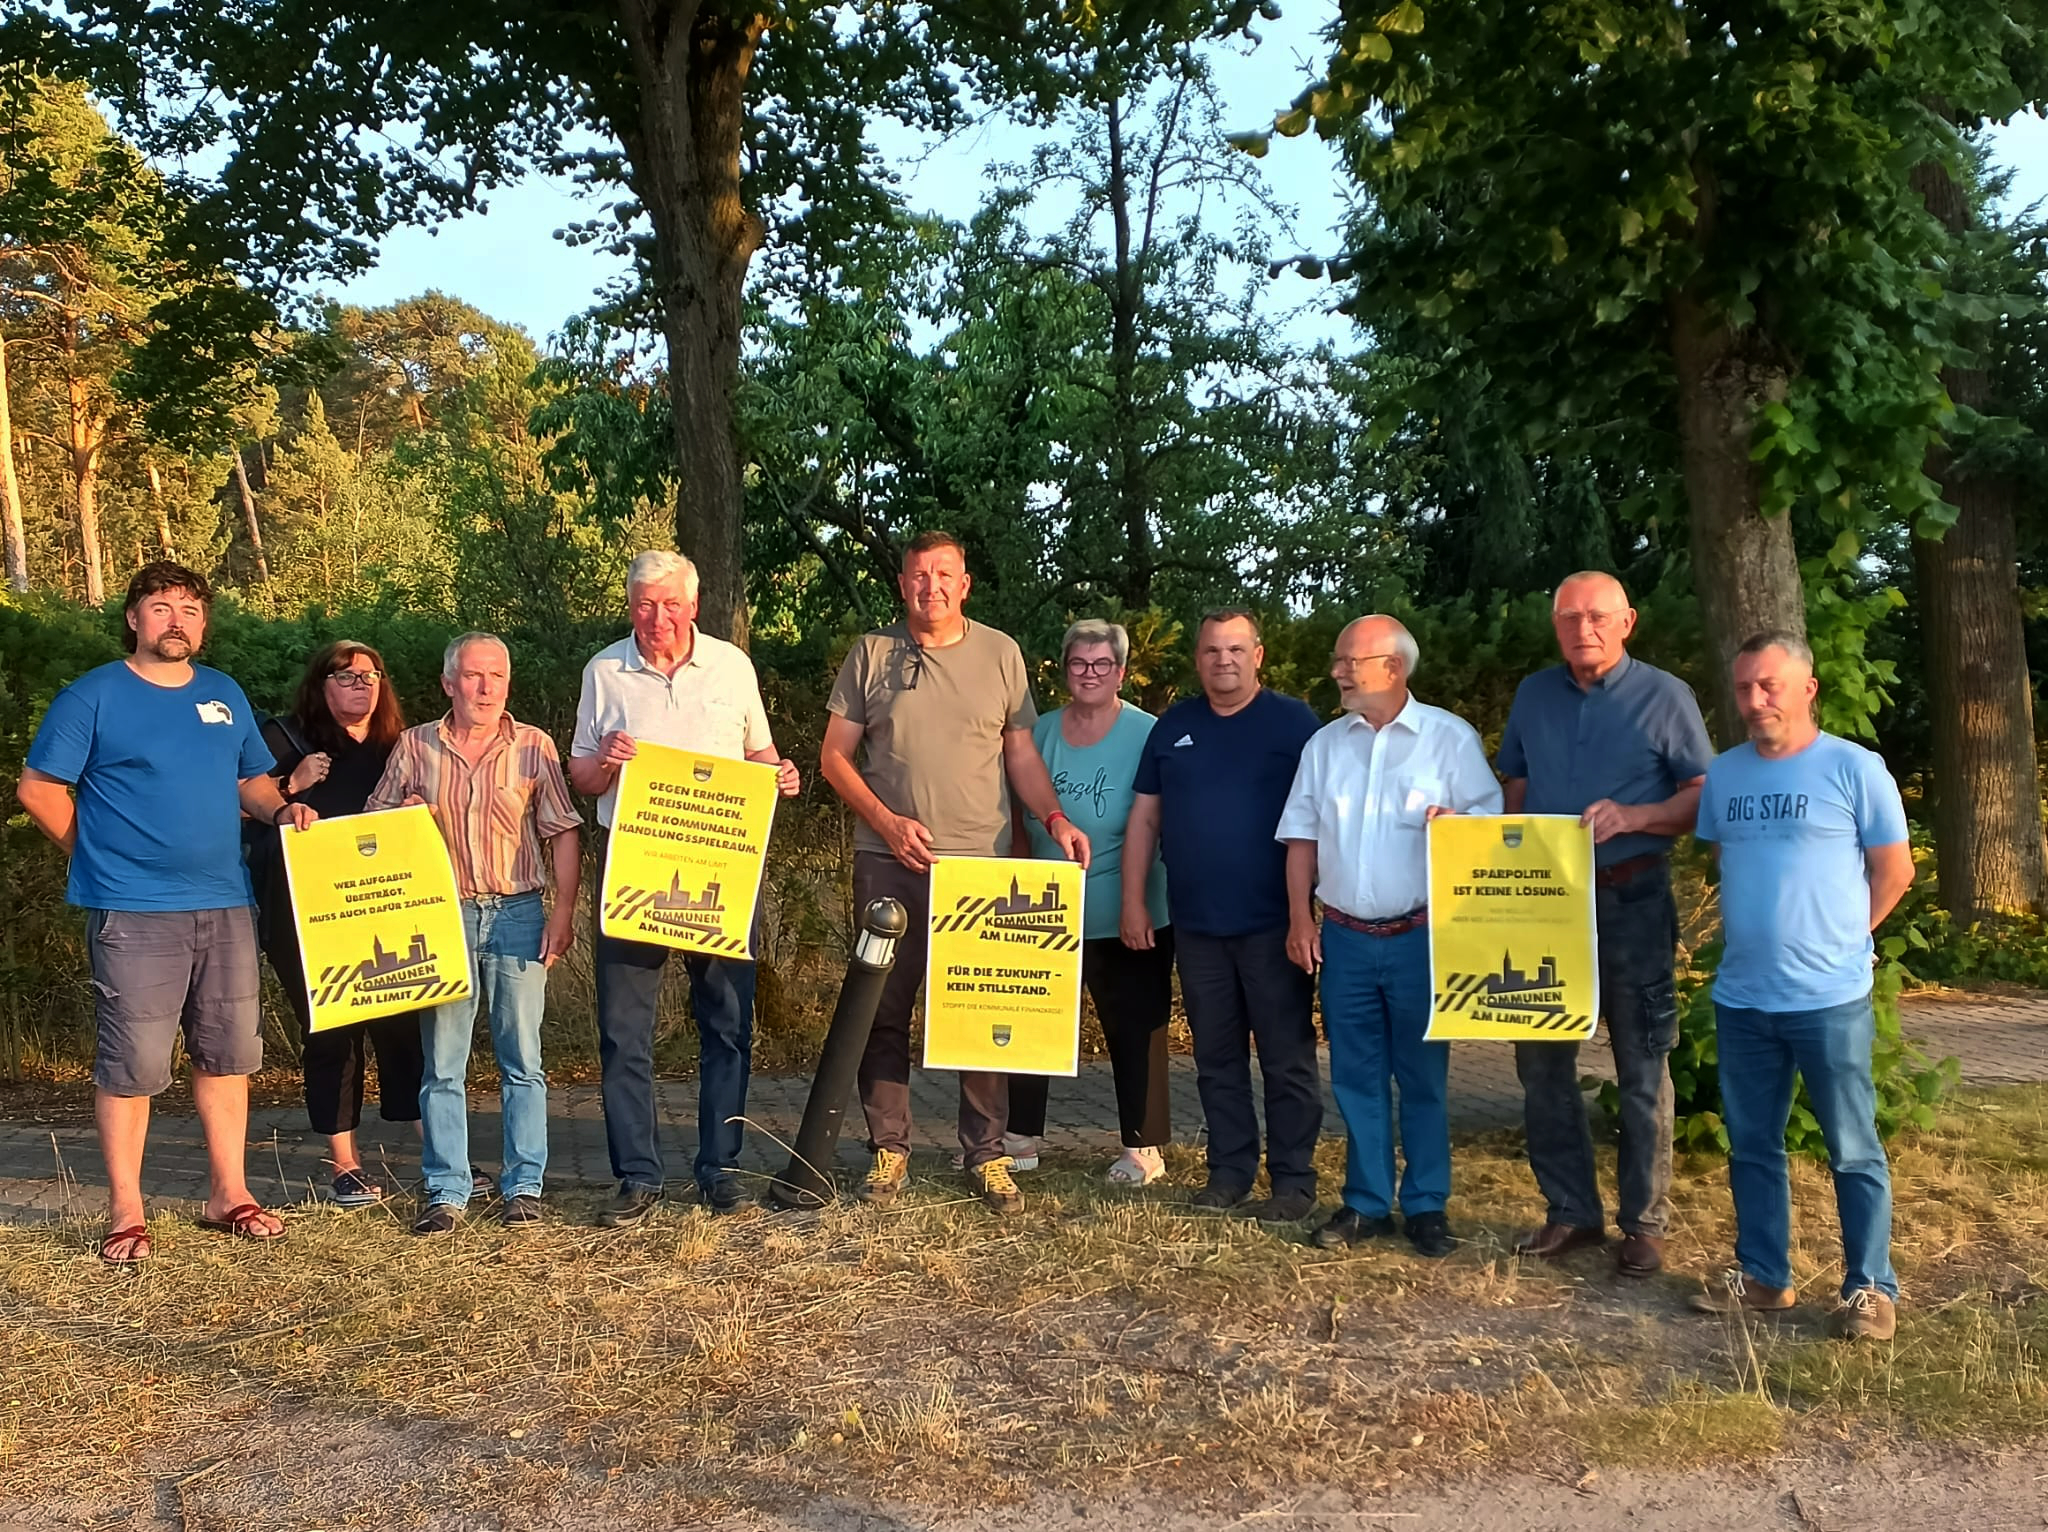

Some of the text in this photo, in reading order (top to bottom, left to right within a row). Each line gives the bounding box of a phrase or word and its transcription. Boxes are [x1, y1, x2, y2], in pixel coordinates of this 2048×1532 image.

[649, 782, 746, 806] GEGEN ERHÖHTE
[649, 796, 743, 820] KREISUMLAGEN.
[1727, 793, 1809, 822] BIG STAR
[636, 810, 747, 838] FÜR KOMMUNALEN
[618, 823, 759, 854] HANDLUNGSSPIELRAUM.
[334, 872, 413, 890] WER AUFGABEN
[1472, 869, 1551, 879] SPARPOLITIK
[1453, 886, 1472, 896] IST
[1475, 886, 1512, 896] KEINE
[309, 896, 446, 924] MUSS AUCH DAFÜR ZAHLEN.
[644, 909, 720, 924] KOMMUNEN
[985, 914, 1064, 927] KOMMUNEN
[638, 922, 696, 941] AM LIMIT
[979, 931, 1039, 945] AM LIMIT
[353, 964, 436, 992] KOMMUNEN
[947, 965, 970, 977] FÜR
[973, 967, 993, 977] DIE
[996, 968, 1051, 980] ZUKUNFT
[946, 982, 1051, 996] KEIN STILLSTAND.
[350, 990, 412, 1007] AM LIMIT
[1477, 991, 1562, 1006] KOMMUNEN
[1470, 1010, 1534, 1025] AM LIMIT
